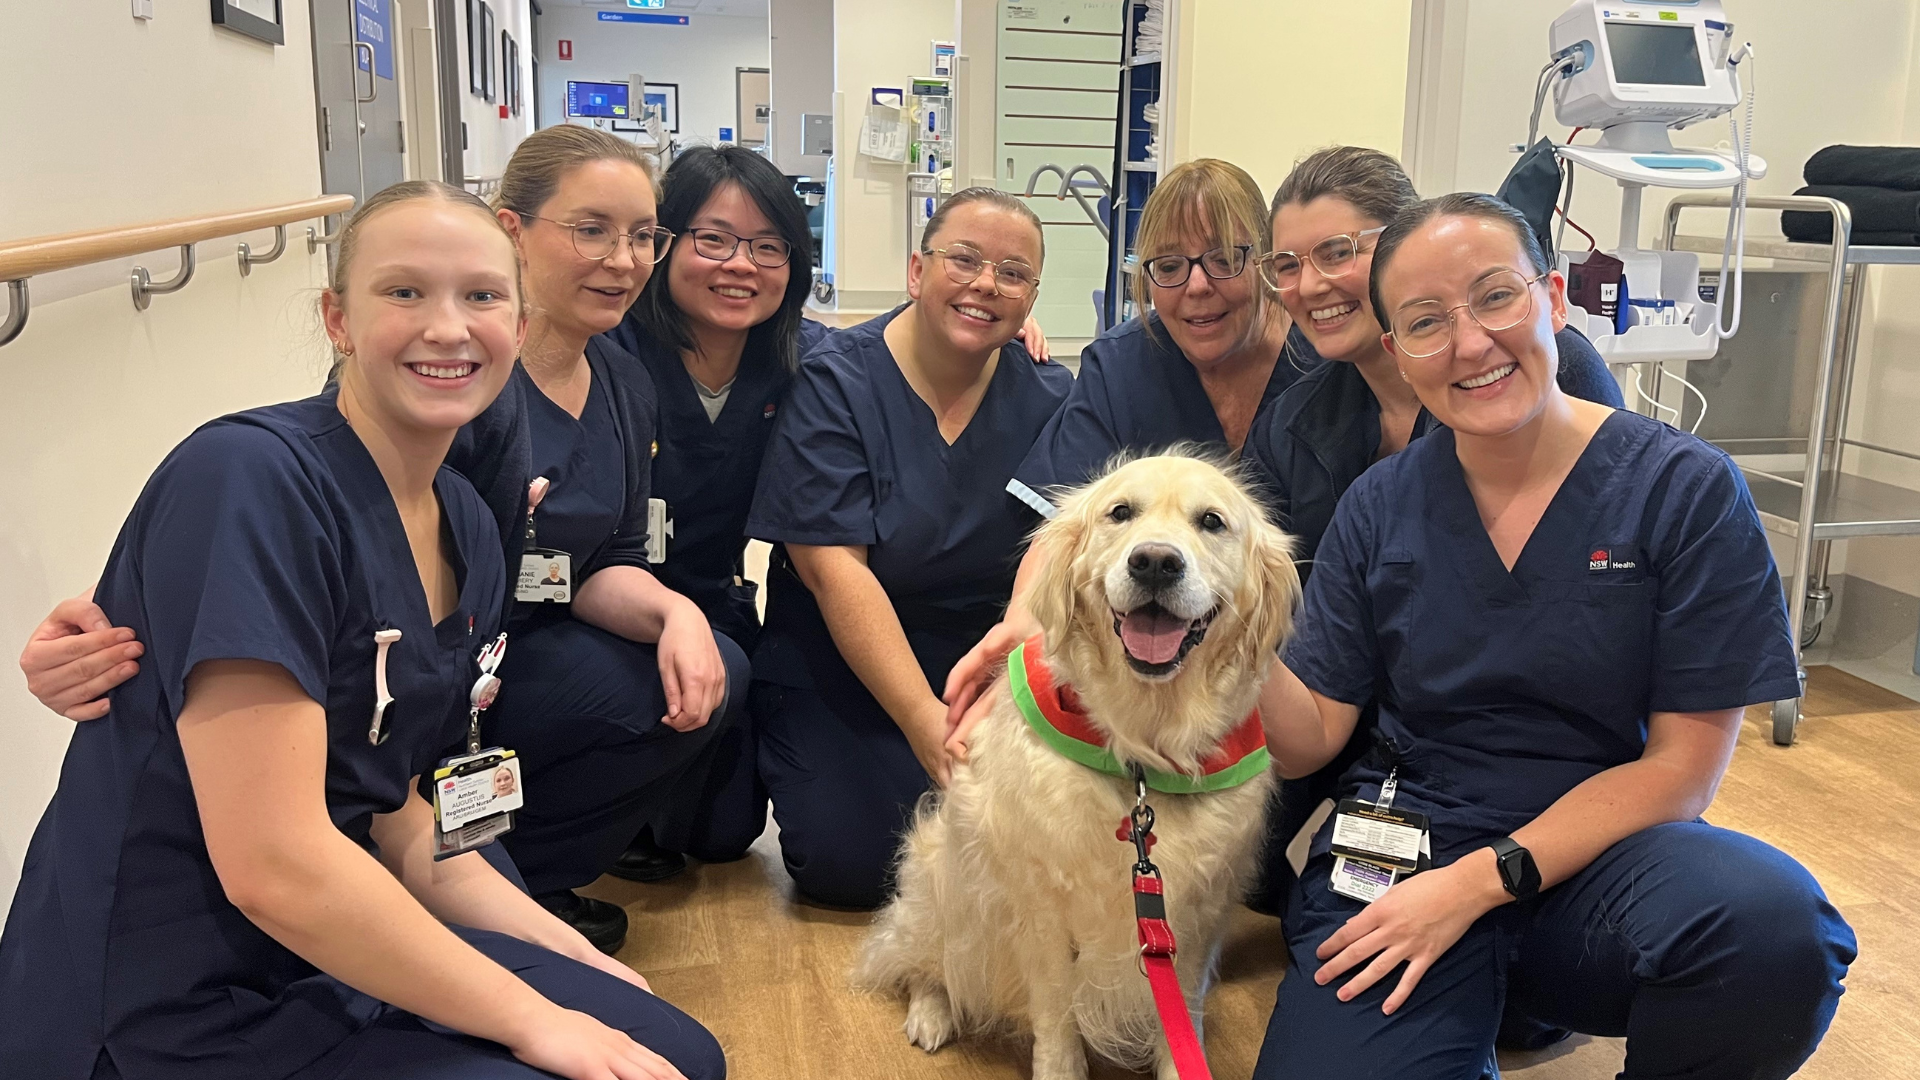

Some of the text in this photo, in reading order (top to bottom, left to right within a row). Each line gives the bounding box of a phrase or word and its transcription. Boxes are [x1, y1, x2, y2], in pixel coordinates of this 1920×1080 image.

[1589, 560, 1636, 569] NSW Health
[458, 789, 479, 800] Amber
[452, 793, 486, 808] AUGUSTUS
[446, 798, 493, 817] Registered Nurse
[1350, 876, 1379, 887] EMERGENCY
